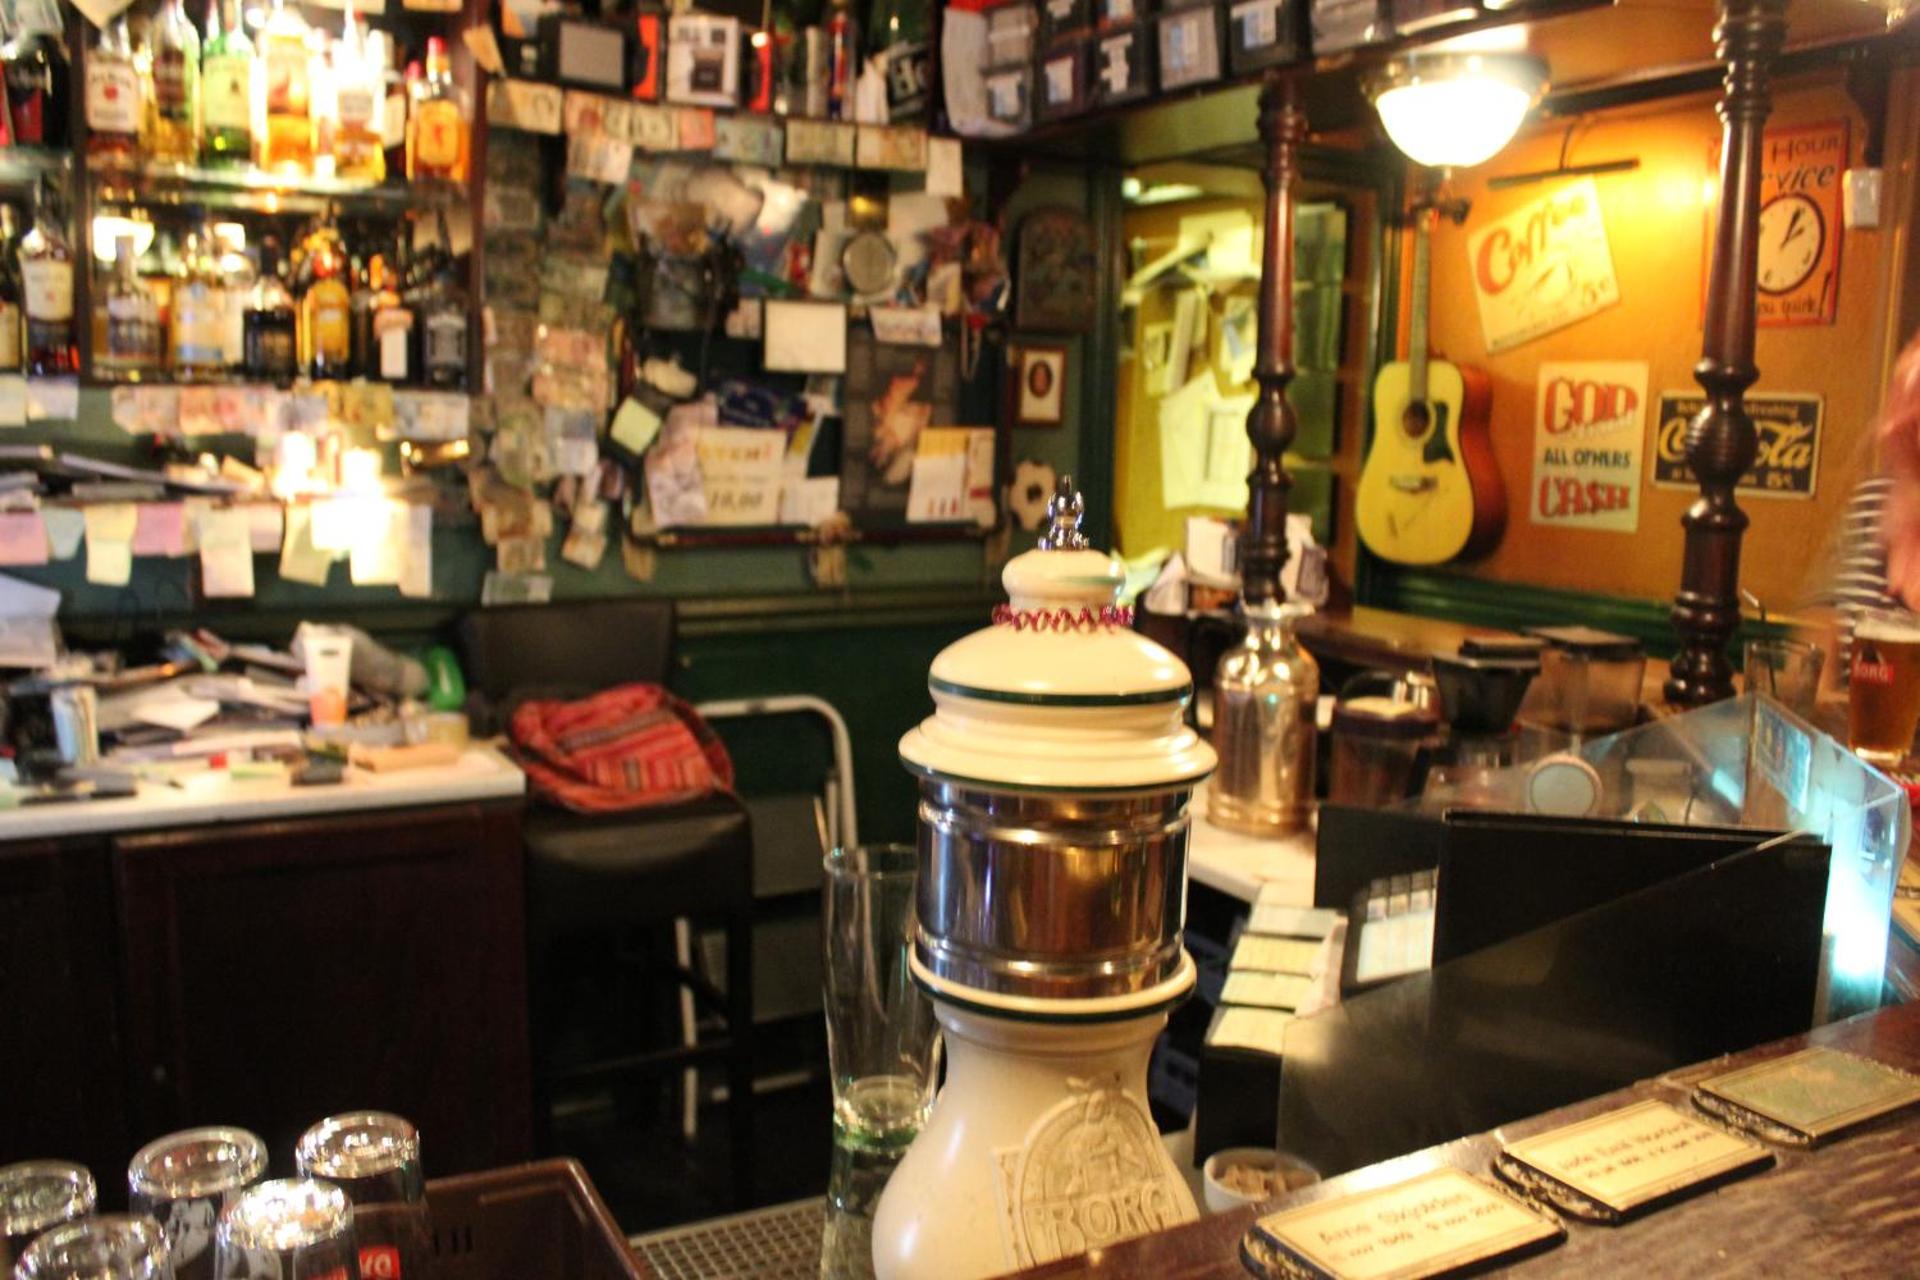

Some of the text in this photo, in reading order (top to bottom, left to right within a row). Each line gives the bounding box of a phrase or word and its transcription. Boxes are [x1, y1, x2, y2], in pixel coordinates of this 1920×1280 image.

[1543, 378, 1640, 435] GOD
[1544, 447, 1631, 468] ALL OTHERS
